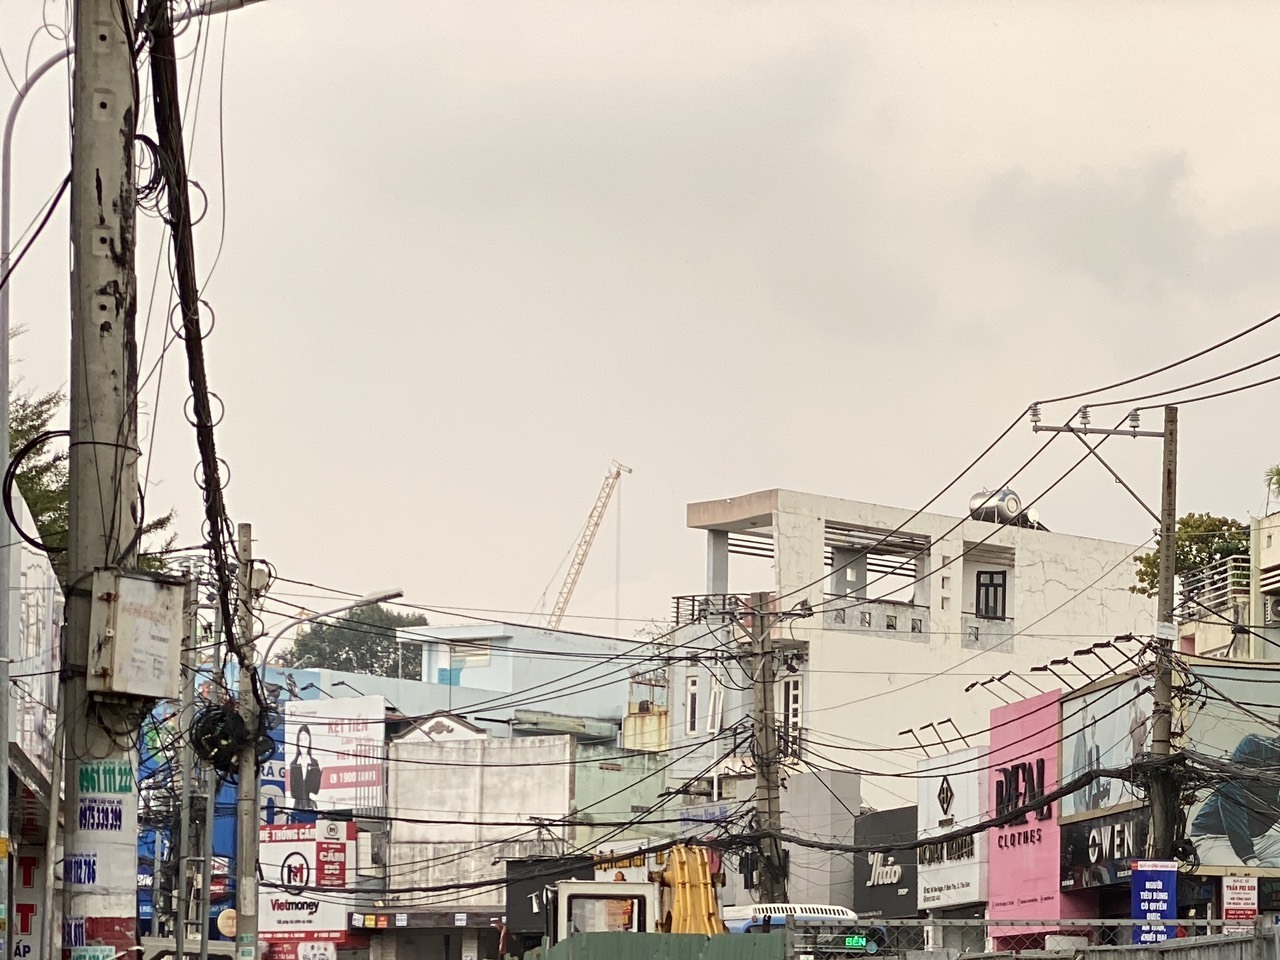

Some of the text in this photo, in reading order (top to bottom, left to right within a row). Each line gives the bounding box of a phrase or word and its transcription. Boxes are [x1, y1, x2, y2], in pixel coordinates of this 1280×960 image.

[997, 828, 1042, 850] CLOTHES
[1088, 821, 1133, 864] OWEN
[270, 898, 320, 914] Vietmoney
